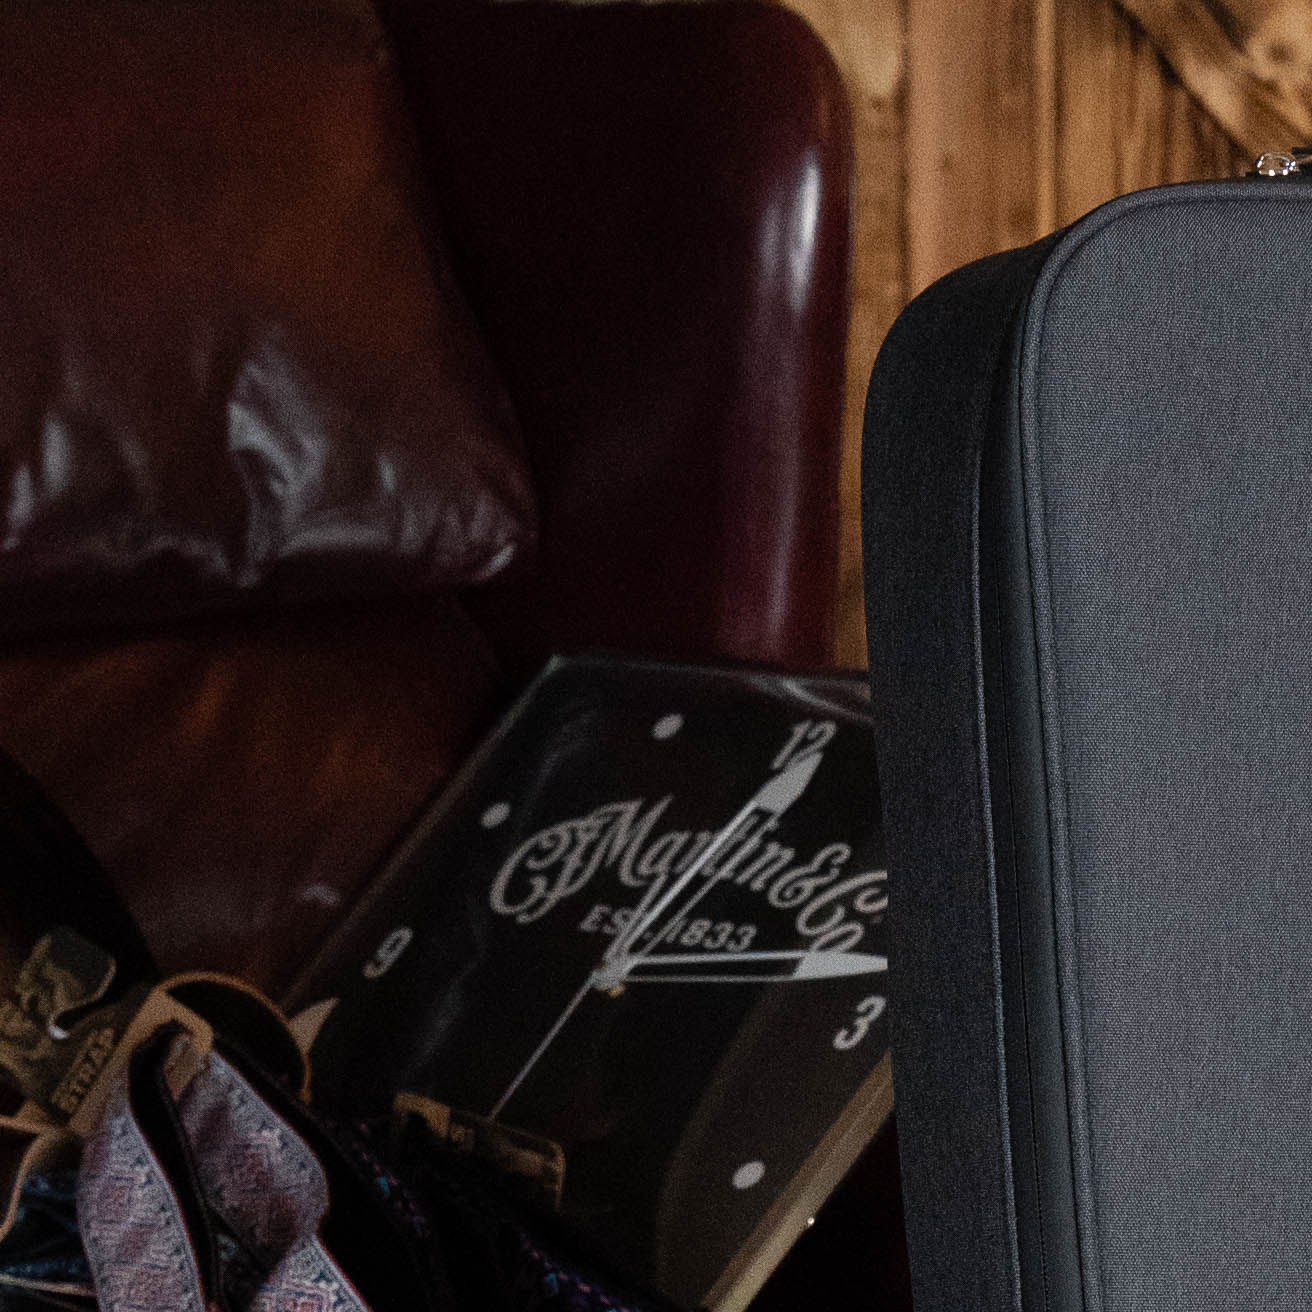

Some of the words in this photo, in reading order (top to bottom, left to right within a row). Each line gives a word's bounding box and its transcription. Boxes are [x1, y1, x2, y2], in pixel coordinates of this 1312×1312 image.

[769, 719, 837, 771] 12
[363, 926, 412, 978] 9
[664, 917, 758, 951] 1833
[832, 996, 886, 1049] 3
